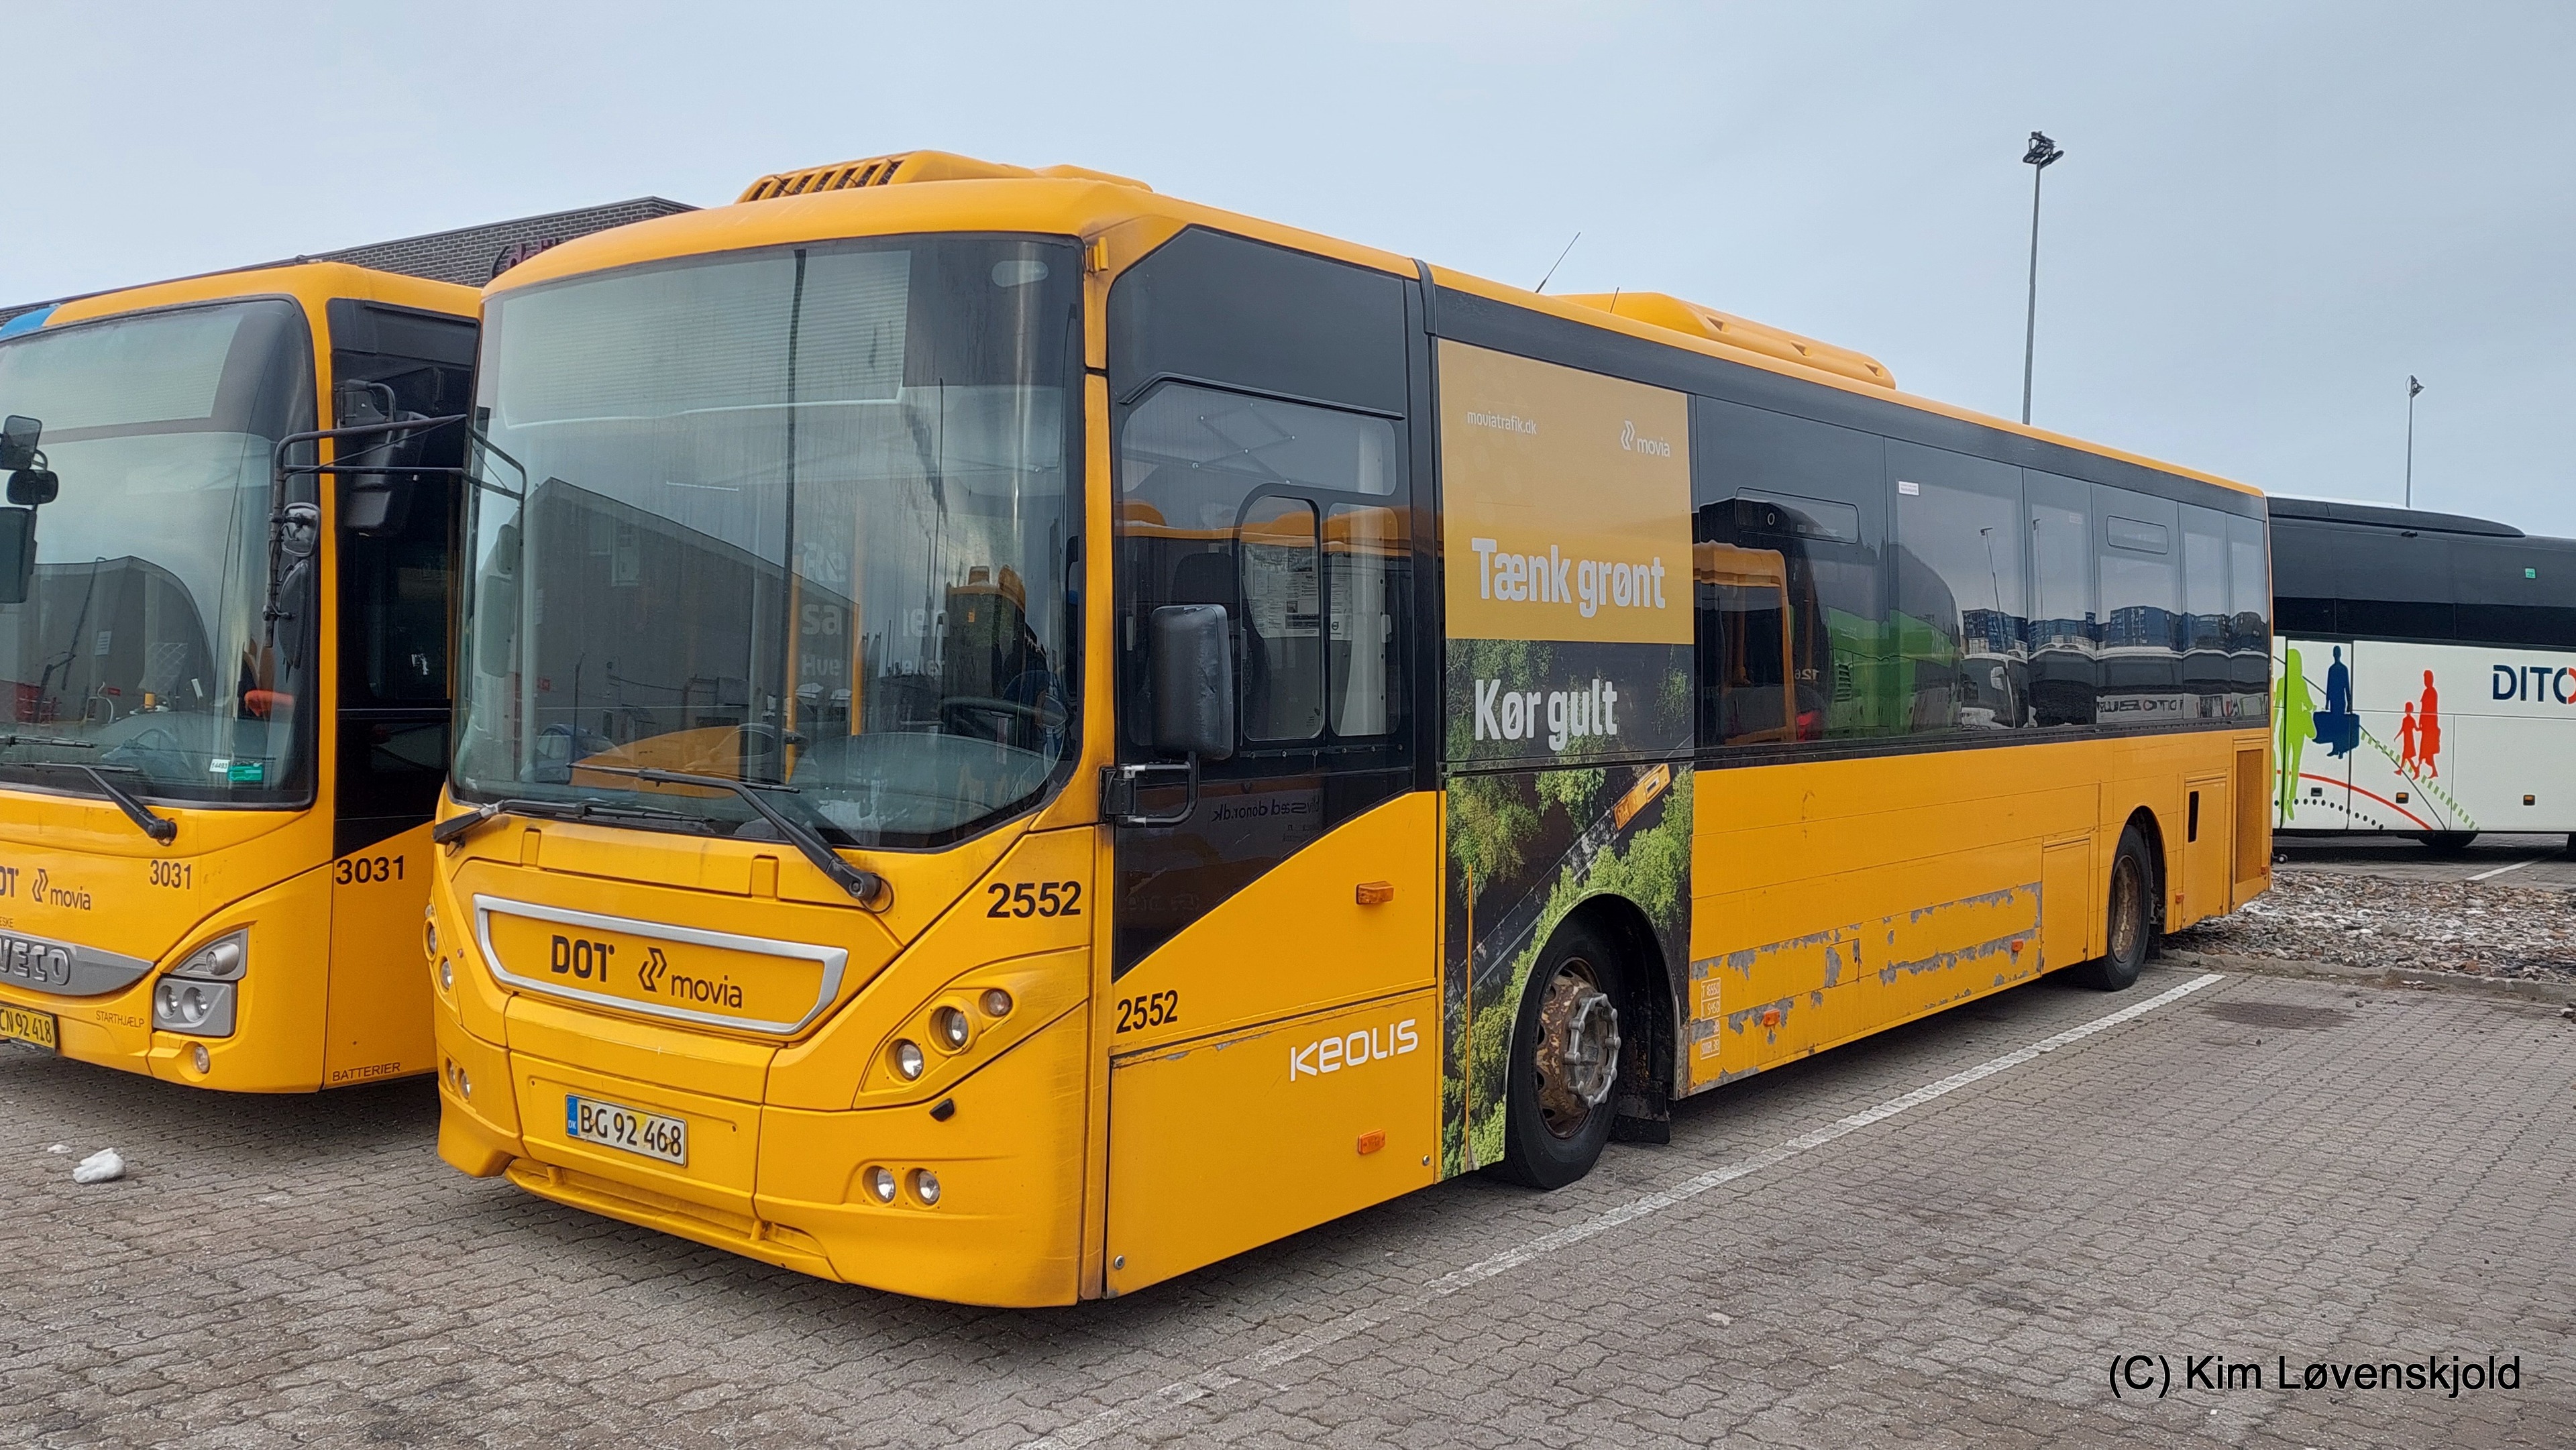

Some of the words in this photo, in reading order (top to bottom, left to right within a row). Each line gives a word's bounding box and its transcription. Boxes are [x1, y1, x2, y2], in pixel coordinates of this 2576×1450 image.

[1466, 410, 1537, 435] moviatrafik.dk
[1637, 437, 1670, 457] movia
[1471, 537, 1572, 604] Tænk
[1578, 557, 1666, 618] grønt
[2493, 665, 2576, 705] DITO
[1475, 679, 1542, 740] Kør
[1548, 679, 1617, 751] gult
[149, 859, 191, 890] 3031
[335, 854, 405, 885] 3031
[50, 885, 91, 911] movia
[986, 881, 1082, 918] 2552
[551, 934, 607, 983] DOT
[671, 974, 743, 1008] movia
[0, 1009, 14, 1033] CN
[15, 1012, 30, 1038] 92
[32, 1017, 52, 1044] 418
[95, 1010, 145, 1028] STARTHJÆLP
[1116, 989, 1179, 1034] 2552
[332, 1062, 401, 1082] BATTERIER
[568, 1119, 577, 1130] DK
[580, 1104, 608, 1139] BG
[613, 1112, 637, 1146] 92
[643, 1120, 682, 1158] 468
